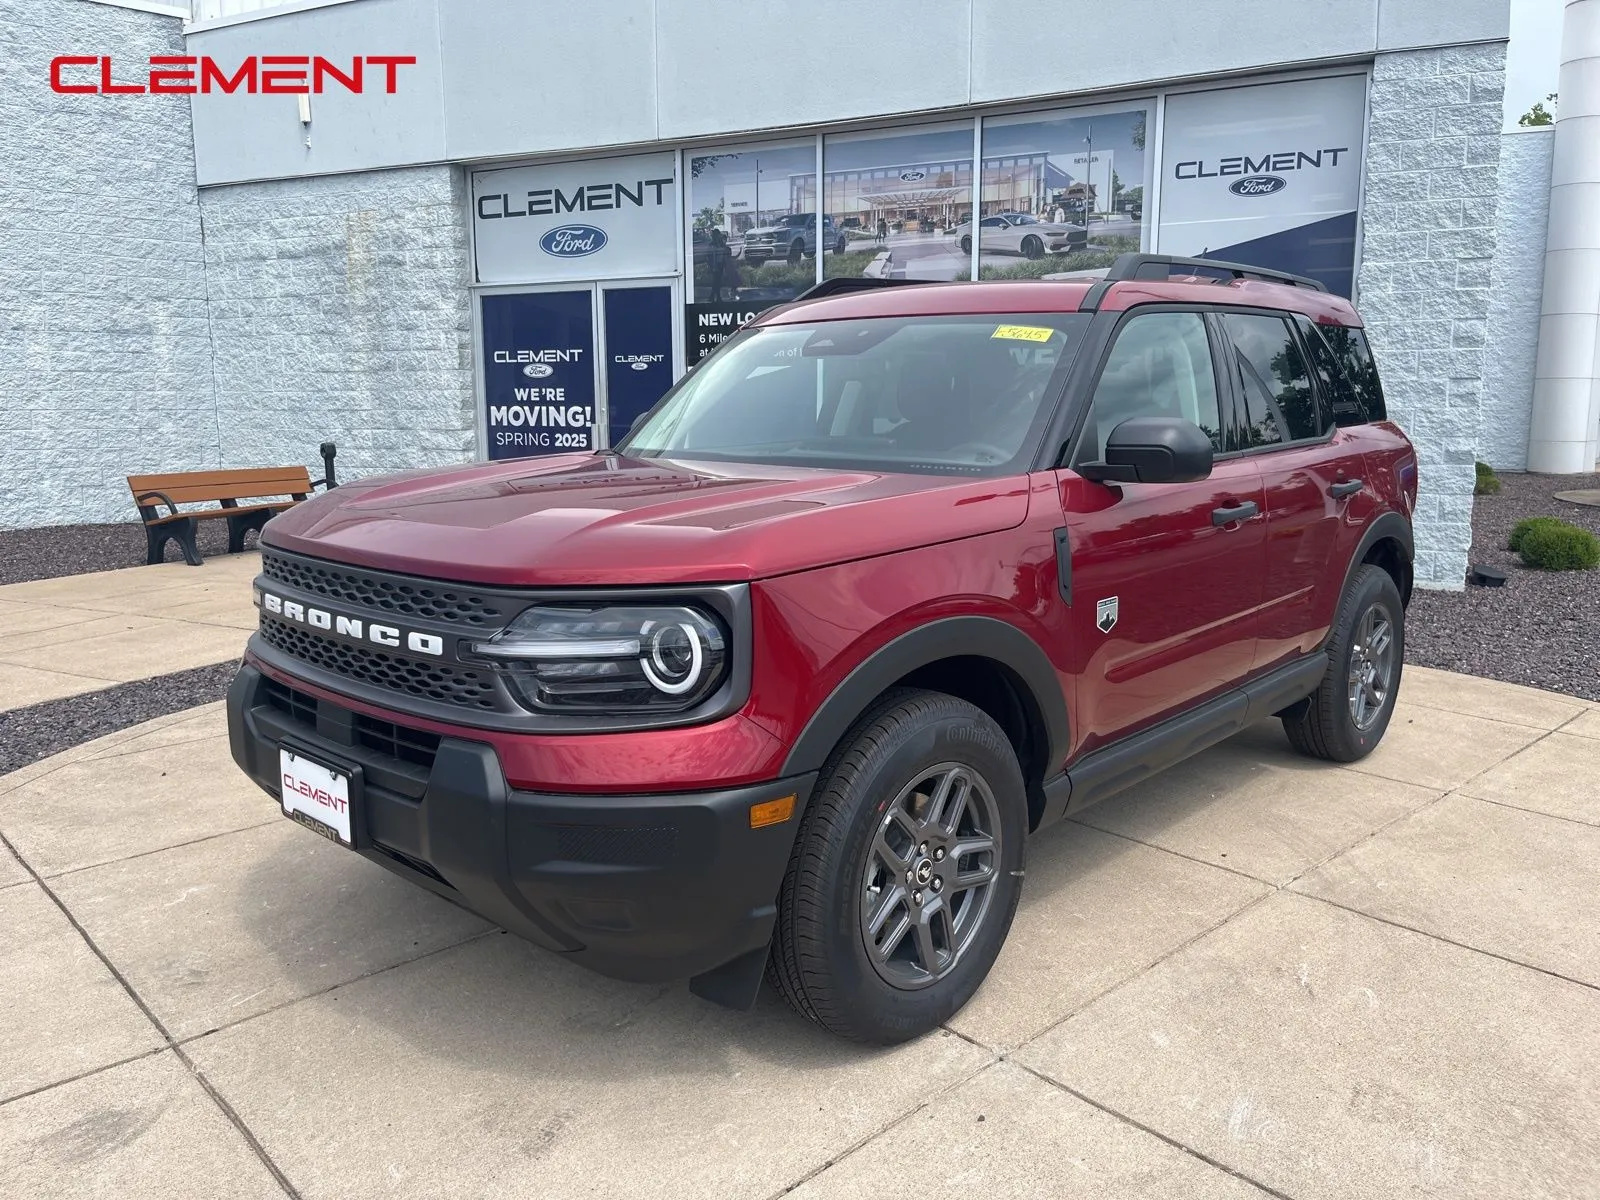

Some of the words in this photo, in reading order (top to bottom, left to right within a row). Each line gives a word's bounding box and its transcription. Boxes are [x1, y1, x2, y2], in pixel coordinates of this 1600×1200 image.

[1175, 148, 1348, 179] CLEMENT
[1238, 177, 1276, 195] Ford
[478, 178, 673, 220] CLEMENT
[550, 228, 596, 254] Ford
[698, 313, 733, 326] NEW
[737, 312, 760, 325] LO
[699, 333, 706, 343] 6
[494, 349, 583, 363] CLEMENT
[615, 355, 664, 363] CLEMENT
[699, 347, 709, 357] at
[527, 365, 549, 376] Ford
[514, 388, 565, 401] WE'RE
[490, 406, 592, 427] MOVING!
[496, 432, 550, 446] SPRING
[554, 433, 587, 447] 2025
[264, 593, 443, 656] BRONCO
[283, 773, 348, 814] CLEMENT
[293, 810, 338, 840] CLEMENT
